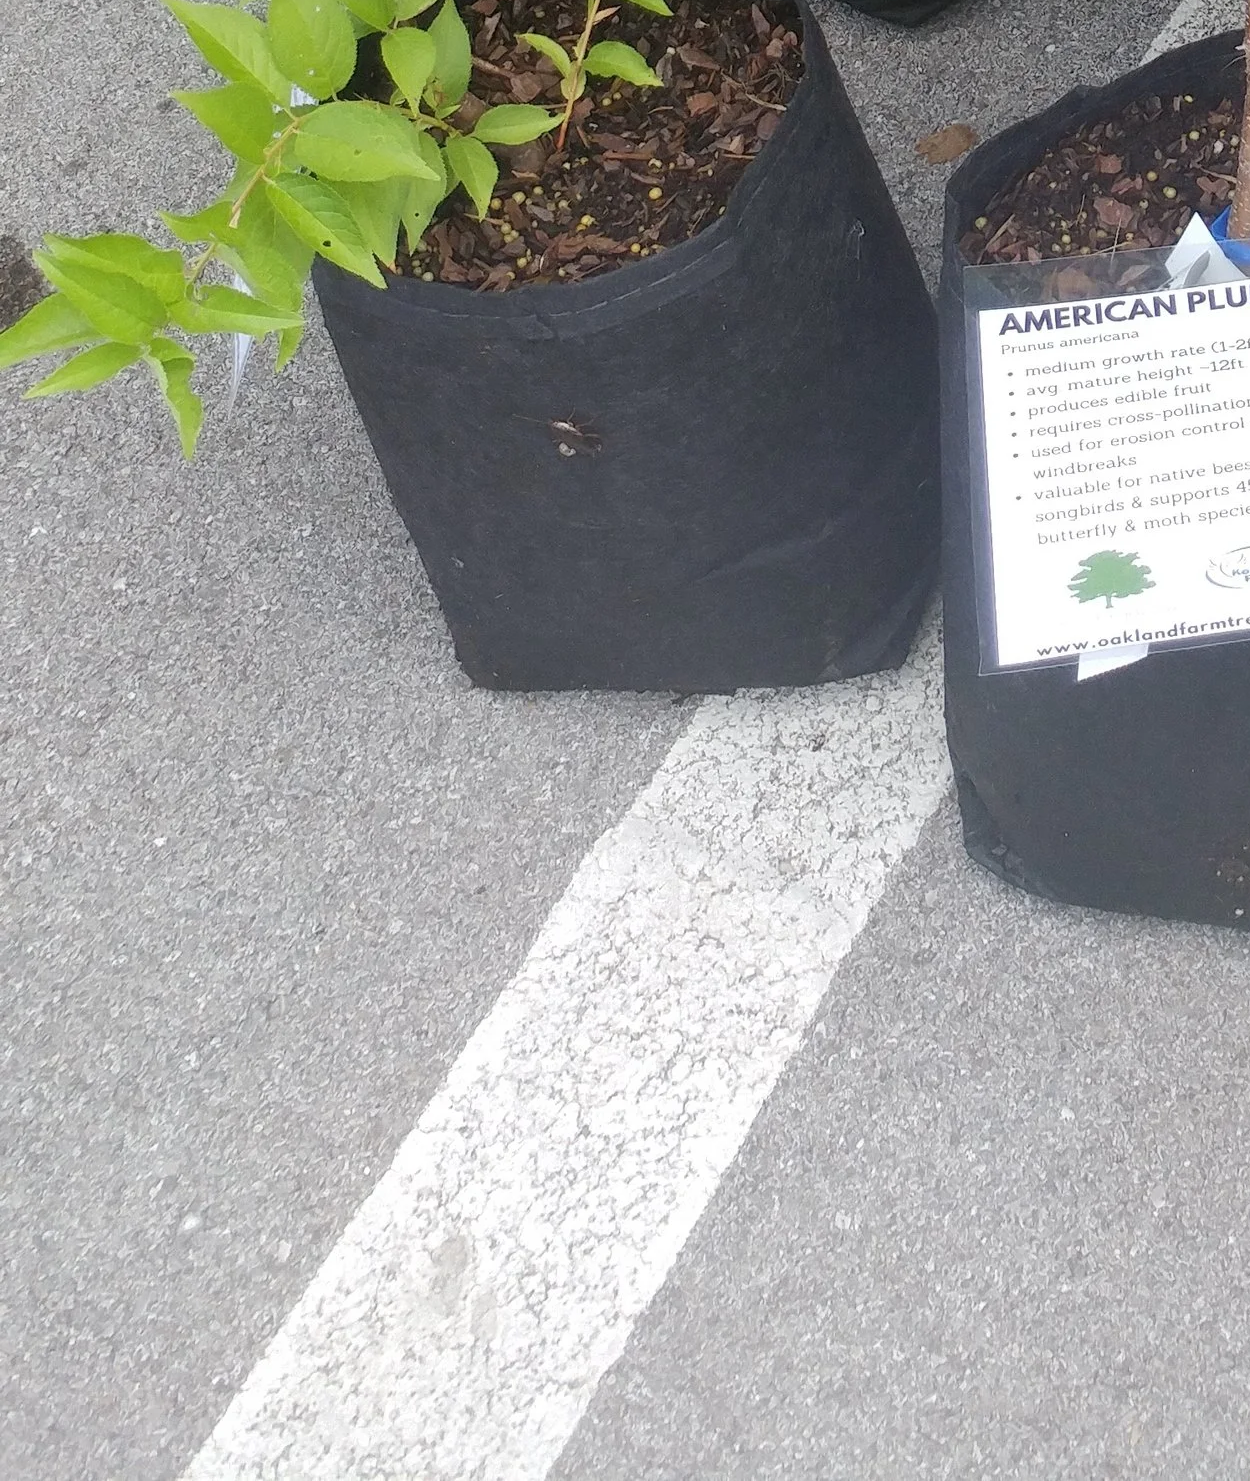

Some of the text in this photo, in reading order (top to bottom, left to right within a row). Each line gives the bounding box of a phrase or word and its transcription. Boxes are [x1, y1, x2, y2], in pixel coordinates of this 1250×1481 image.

[998, 294, 1178, 336] AMERICAN
[1001, 330, 1140, 355] Prunus americana
[1025, 358, 1096, 378] medium
[1102, 348, 1165, 370] growth
[1170, 344, 1206, 359] rate
[1068, 373, 1131, 391] mature
[1137, 364, 1193, 383] height
[1028, 381, 1212, 420] produces edible fruit
[1029, 418, 1102, 438] requires
[1031, 443, 1072, 458] used
[1078, 438, 1104, 452] for
[1110, 428, 1175, 447] erosion
[1181, 417, 1245, 436] control
[1033, 454, 1137, 479] windbreaks
[1034, 480, 1111, 501] valuable
[1117, 476, 1142, 489] for
[1149, 466, 1206, 485] native
[1035, 499, 1125, 524] songbirds
[1131, 495, 1143, 509] &
[1149, 485, 1230, 507] supports
[1037, 522, 1117, 545] butterfly
[1124, 519, 1137, 532] &
[1143, 512, 1191, 530] moth
